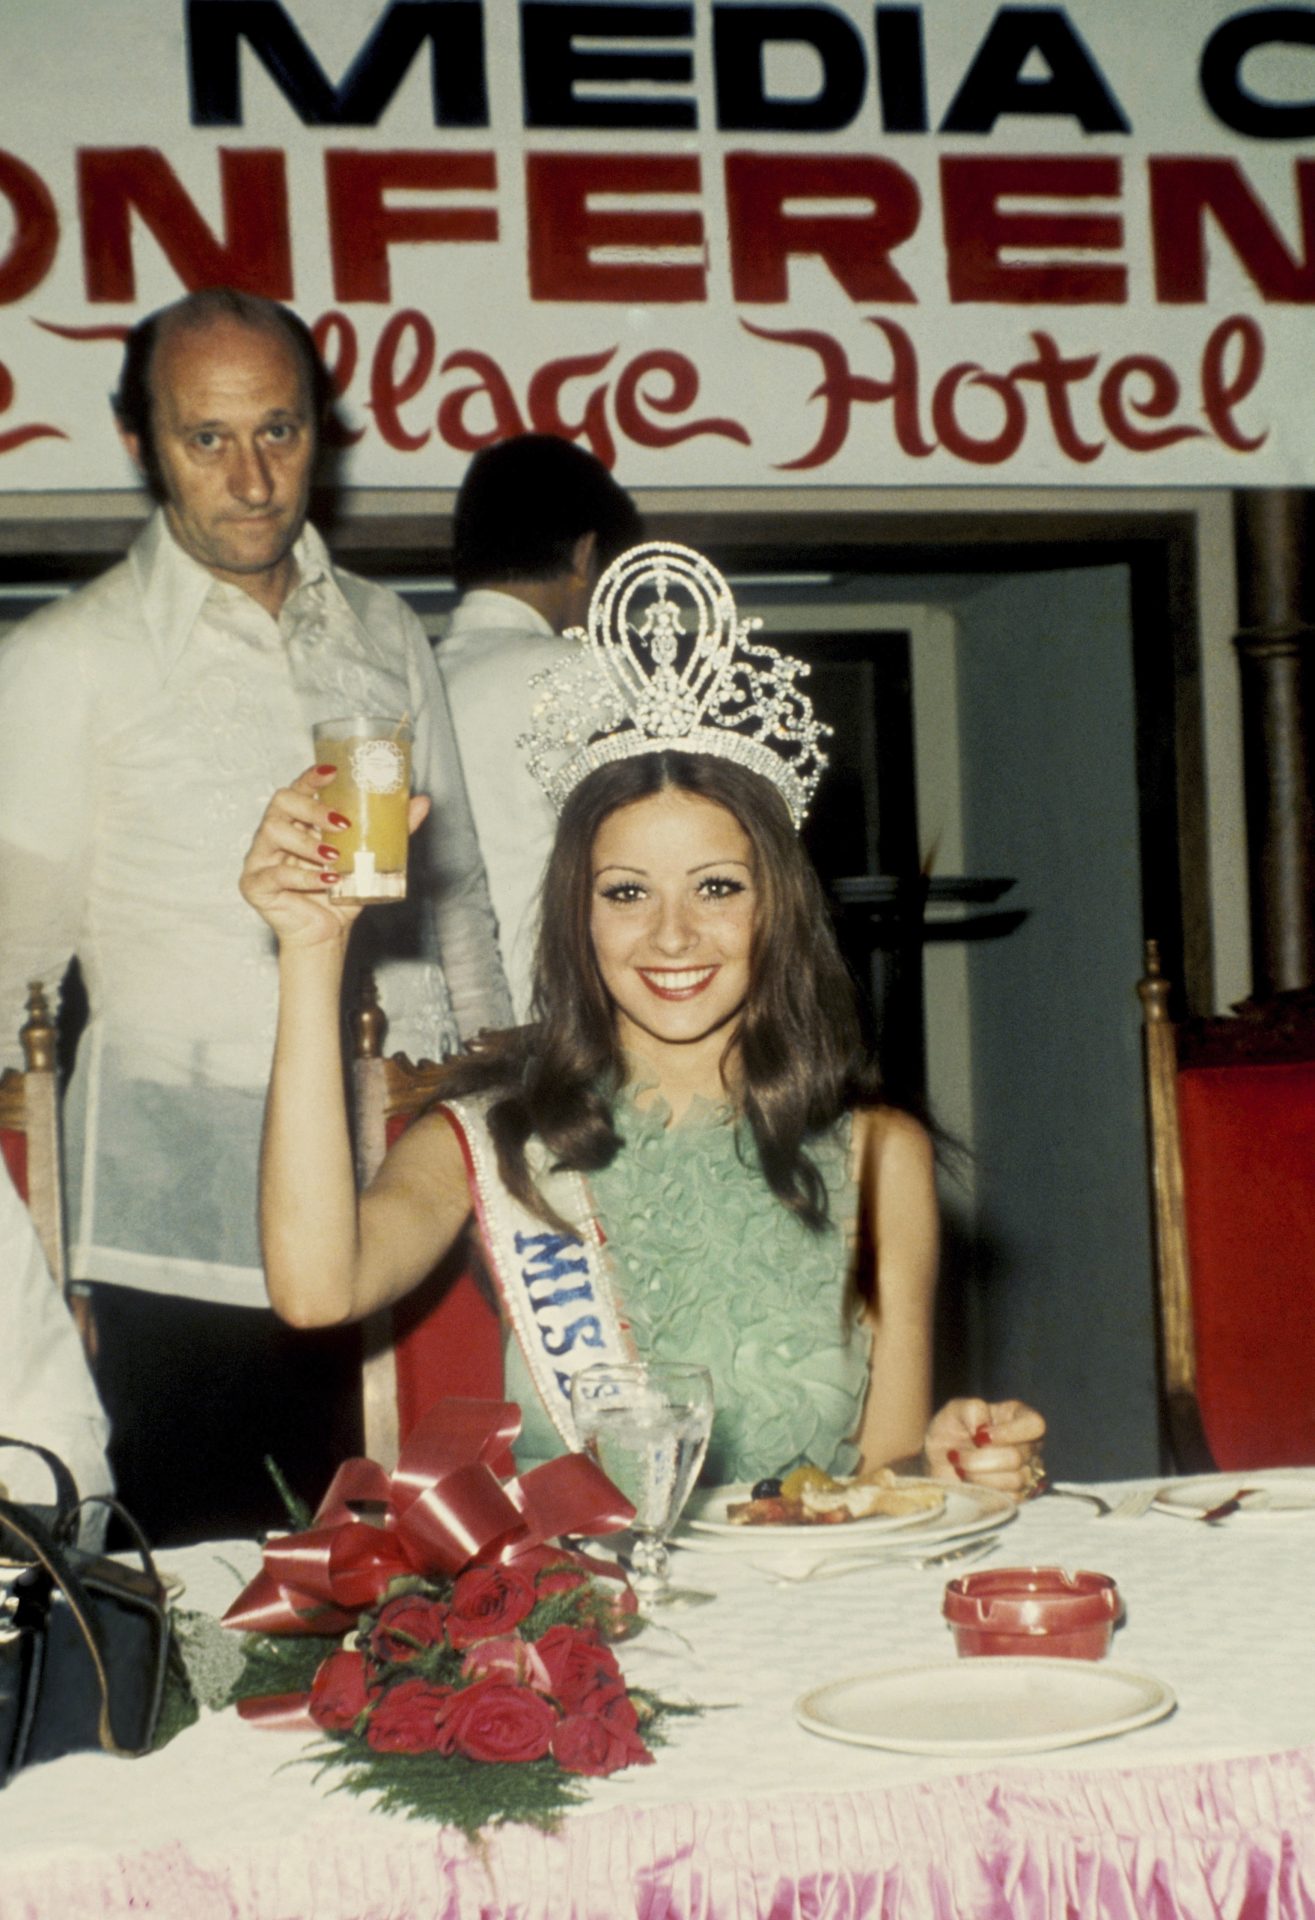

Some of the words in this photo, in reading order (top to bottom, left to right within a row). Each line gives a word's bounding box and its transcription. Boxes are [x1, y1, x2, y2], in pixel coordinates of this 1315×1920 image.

[184, 0, 1132, 136] MEDIA
[28, 308, 753, 472] llage
[739, 314, 1270, 470] Hotel
